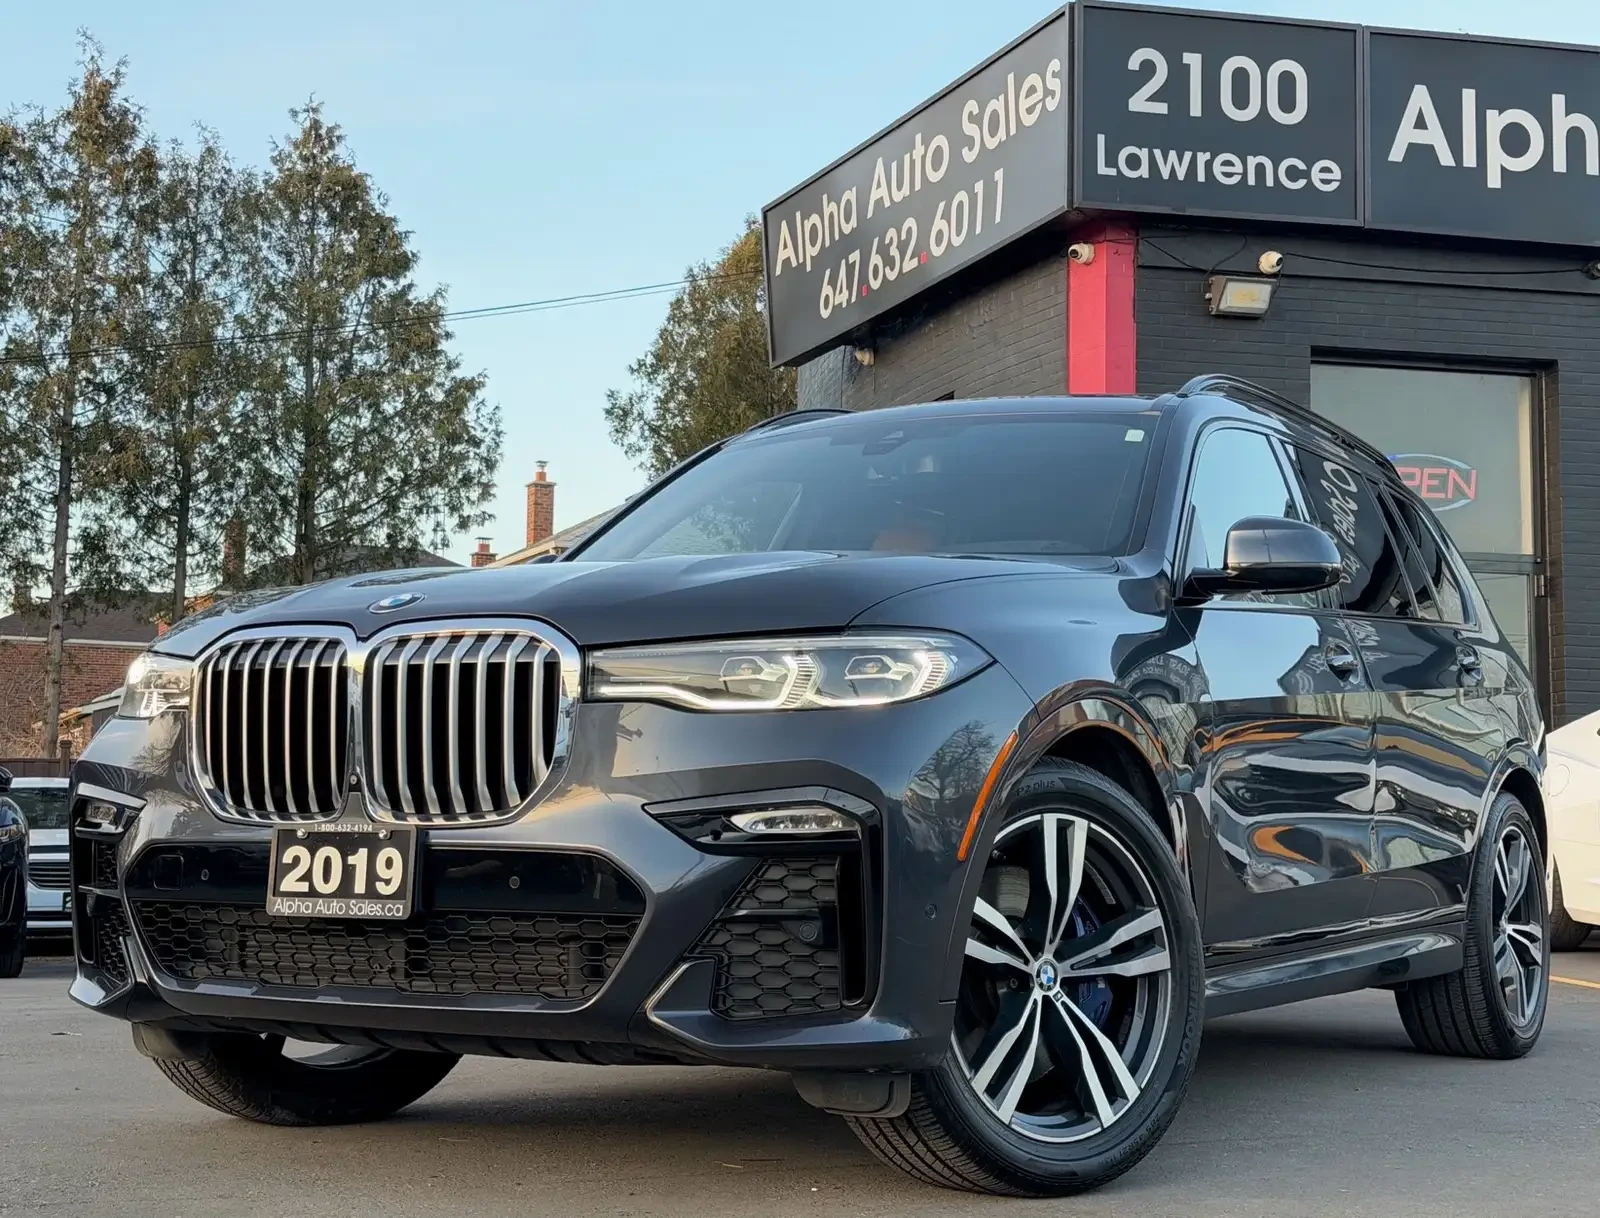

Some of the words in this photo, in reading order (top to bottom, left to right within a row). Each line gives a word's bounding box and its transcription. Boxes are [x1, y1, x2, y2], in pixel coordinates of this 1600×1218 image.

[1127, 47, 1308, 125] 2100
[775, 185, 858, 277] Alpha
[866, 132, 950, 219] Auto
[961, 58, 1062, 164] Sales
[1096, 133, 1342, 192] Lawrence
[1387, 84, 1600, 189] Alph
[819, 167, 1004, 319] 647.632.6011
[1396, 466, 1477, 500] PEN
[279, 845, 404, 896] 2019
[273, 898, 313, 916] Alpha
[314, 899, 346, 915] Auto
[348, 900, 404, 917] Sales.ca
